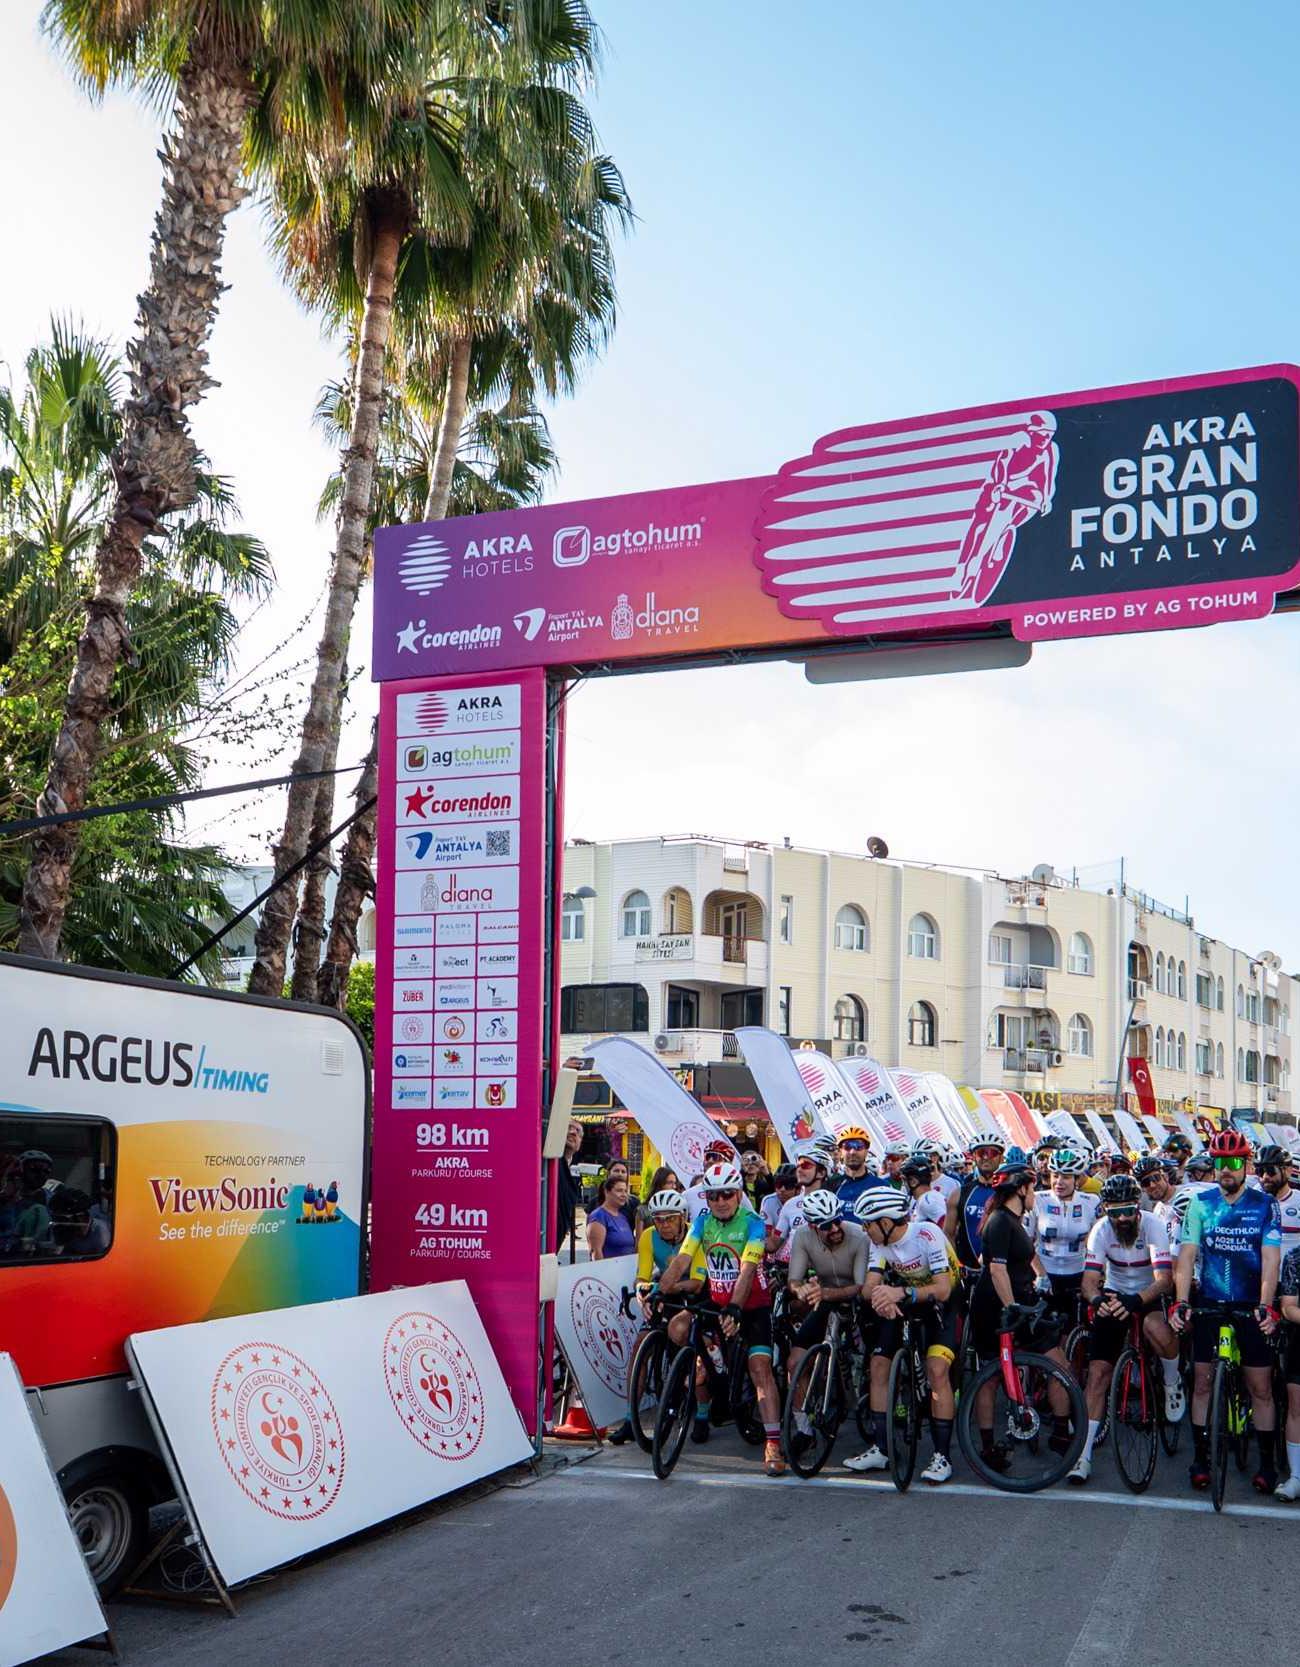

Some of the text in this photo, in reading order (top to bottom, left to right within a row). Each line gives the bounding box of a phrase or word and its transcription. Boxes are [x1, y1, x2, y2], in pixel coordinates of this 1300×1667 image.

[1142, 412, 1257, 450] AKRA
[1103, 442, 1258, 499] GRAN
[1070, 489, 1258, 548] FONDO
[464, 534, 533, 560] AKRA
[593, 523, 701, 555] agtohum
[1070, 534, 1257, 571] ANTALYA
[463, 556, 534, 579] HOTELS
[1023, 591, 1258, 627] POWERED BY AG TOHUM
[548, 615, 604, 632] ANTALYA
[646, 625, 699, 637] TRAVEL
[422, 624, 502, 648] corendon
[458, 639, 500, 651] AIRLINES
[548, 631, 579, 643] Airport
[457, 695, 503, 711] AKRA
[456, 710, 503, 723] HOTELS
[431, 744, 511, 767] agtohum
[431, 792, 511, 814] corendon
[435, 841, 482, 853] ANTALYA
[435, 853, 462, 862] Airport
[27, 1027, 193, 1087] ARGEUS
[416, 1123, 489, 1146] 98 km
[204, 1155, 306, 1167] TECHNOLOGY PARTNER
[435, 1157, 469, 1169] AKRA
[411, 1168, 451, 1178] PARKURU
[458, 1168, 493, 1178] COURSE
[149, 1177, 289, 1215] ViewSonic
[414, 1203, 488, 1226] 49 km
[159, 1222, 186, 1241] See
[190, 1221, 213, 1238] the
[419, 1237, 482, 1249] AG TOHUM
[410, 1249, 450, 1258] PARKURU
[457, 1250, 492, 1260] COURSE
[288, 1382, 299, 1395] VE
[300, 1394, 317, 1421] SPOR
